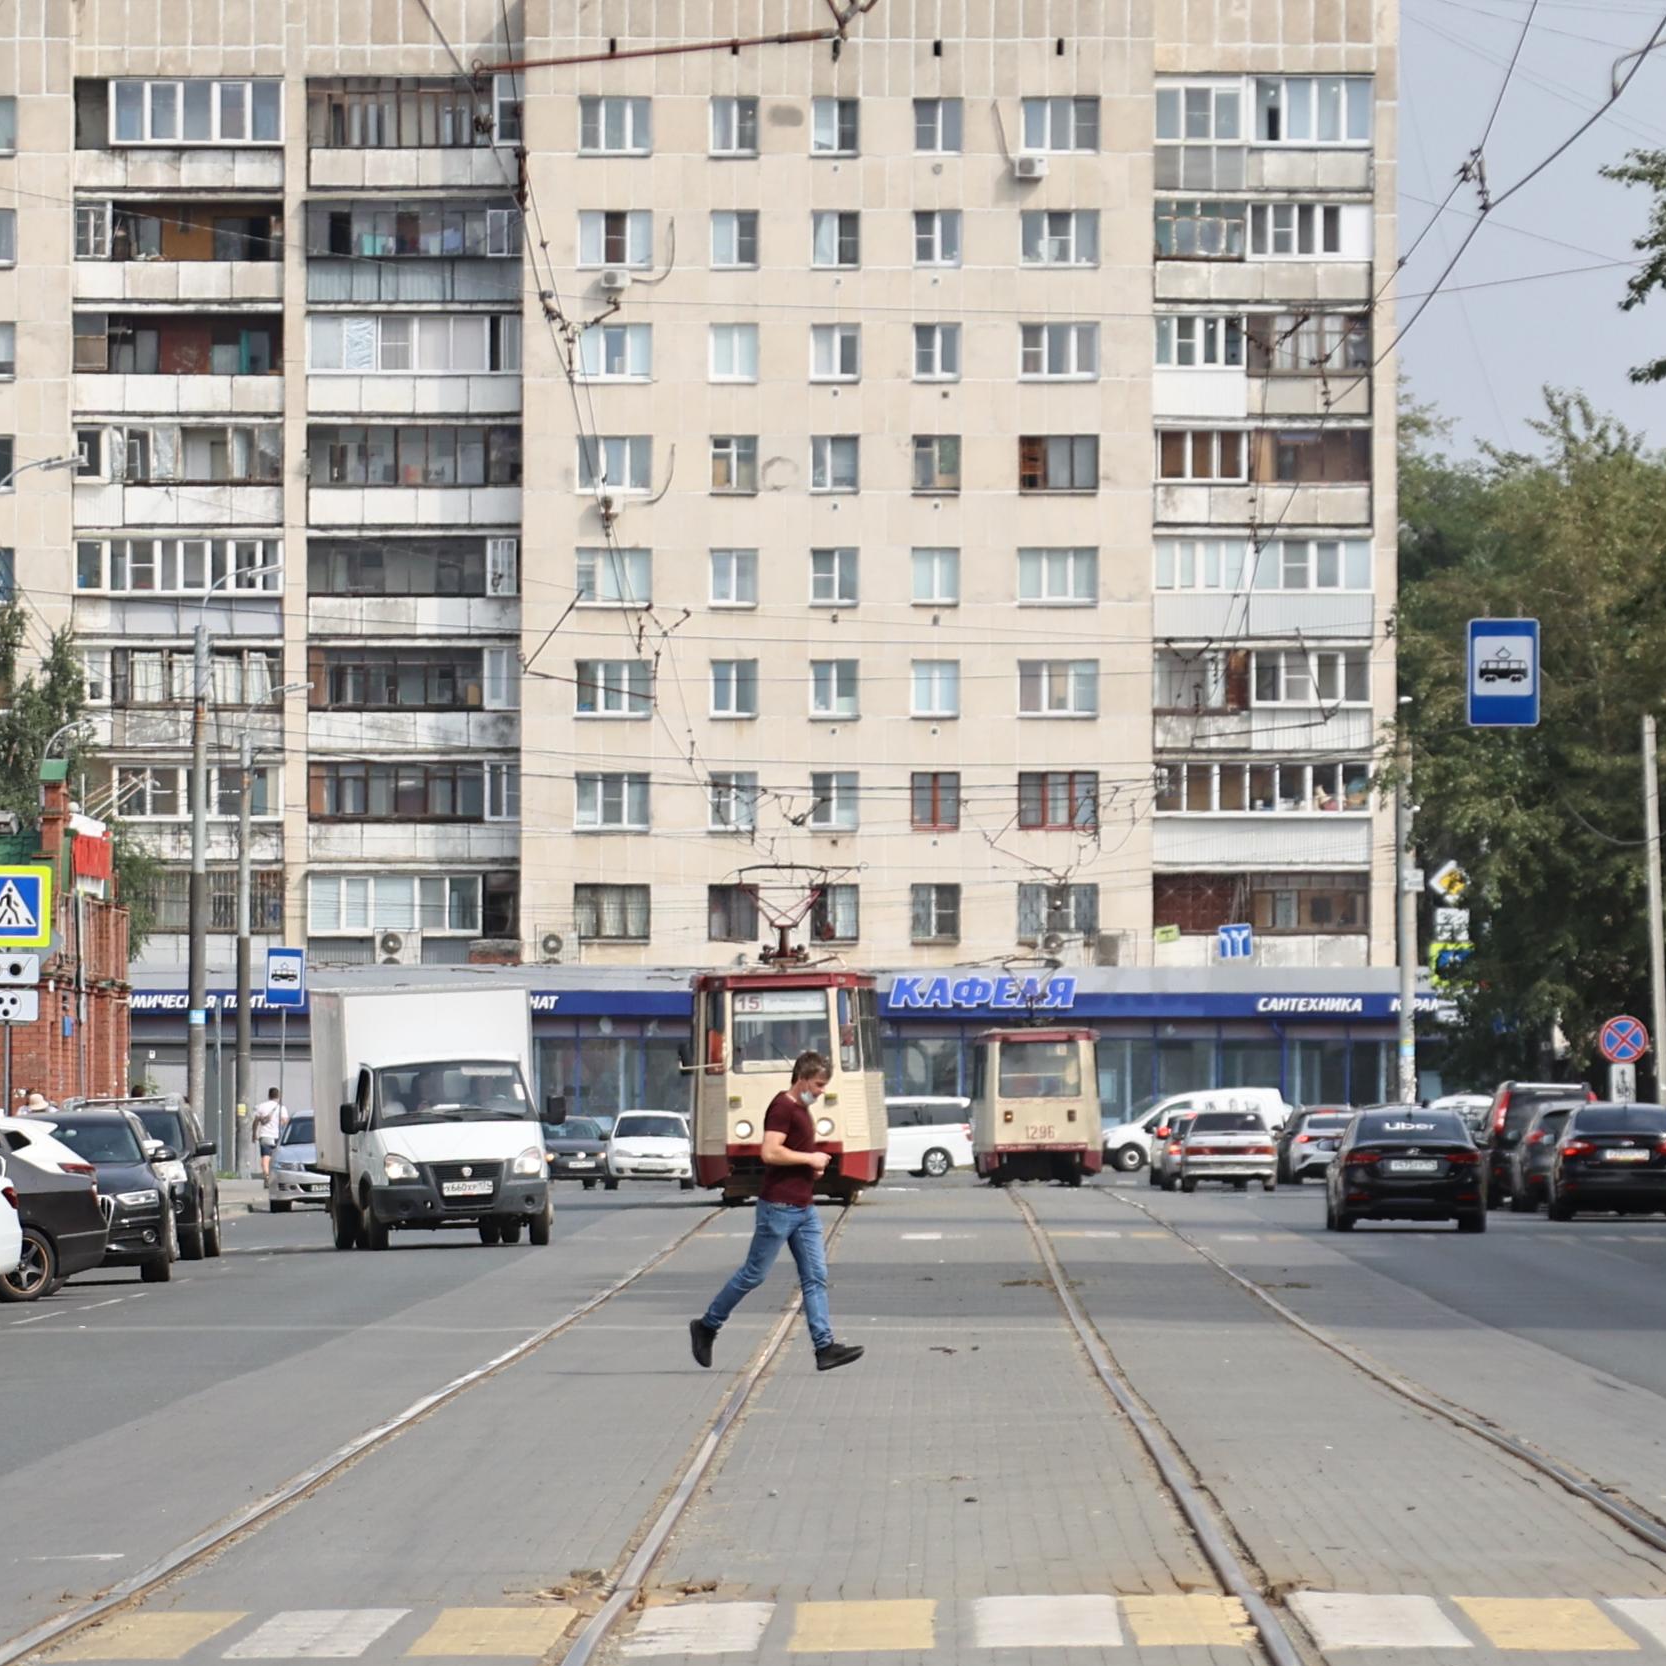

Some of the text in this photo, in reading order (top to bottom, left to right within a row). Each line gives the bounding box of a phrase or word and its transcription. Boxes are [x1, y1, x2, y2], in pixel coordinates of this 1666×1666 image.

[889, 976, 1077, 1008] КАФЕЛЯ
[737, 995, 760, 1010] 15
[1257, 997, 1363, 1012] САНТЕХНИКА
[1025, 1125, 1056, 1140] 1296
[1384, 1121, 1438, 1131] Uber
